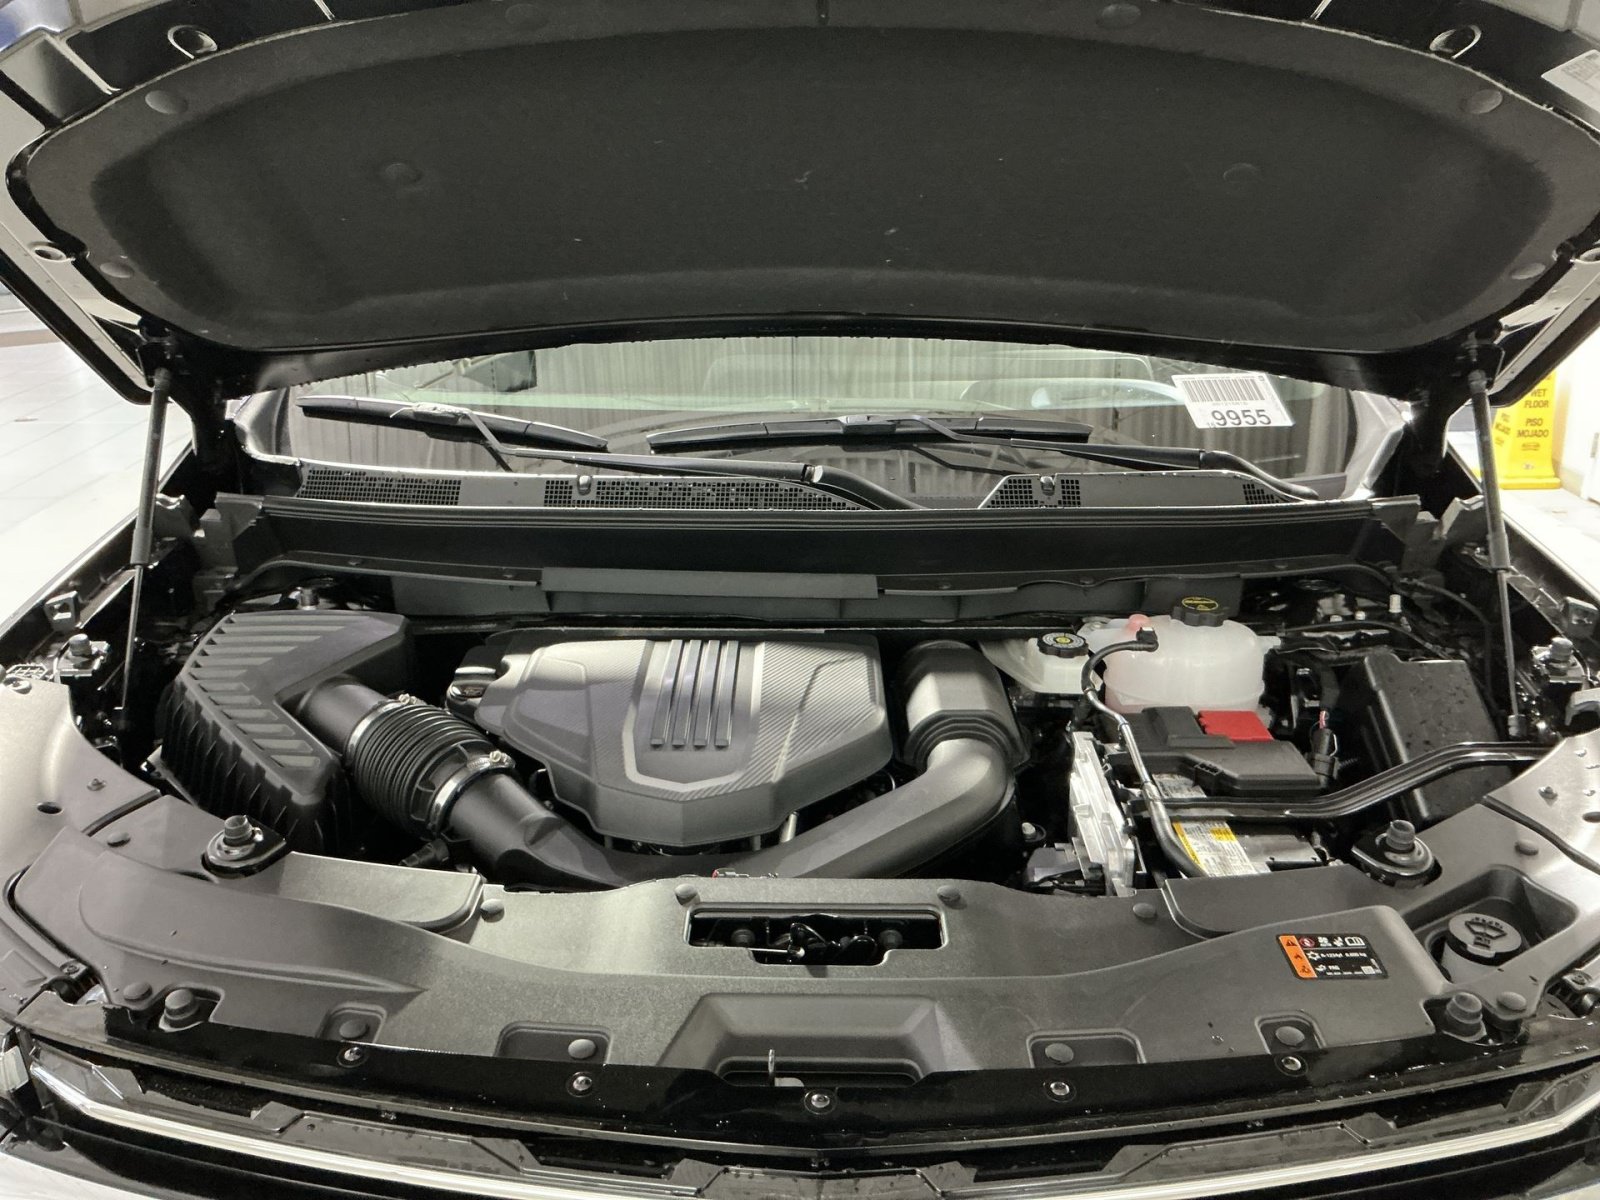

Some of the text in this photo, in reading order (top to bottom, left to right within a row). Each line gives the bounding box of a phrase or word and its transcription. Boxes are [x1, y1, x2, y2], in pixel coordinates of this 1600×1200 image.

[1530, 388, 1547, 397] WET
[1523, 400, 1549, 408] FLOOR
[1211, 409, 1272, 426] 9955
[1525, 418, 1544, 427] PISO
[1516, 429, 1549, 438] MOJADO
